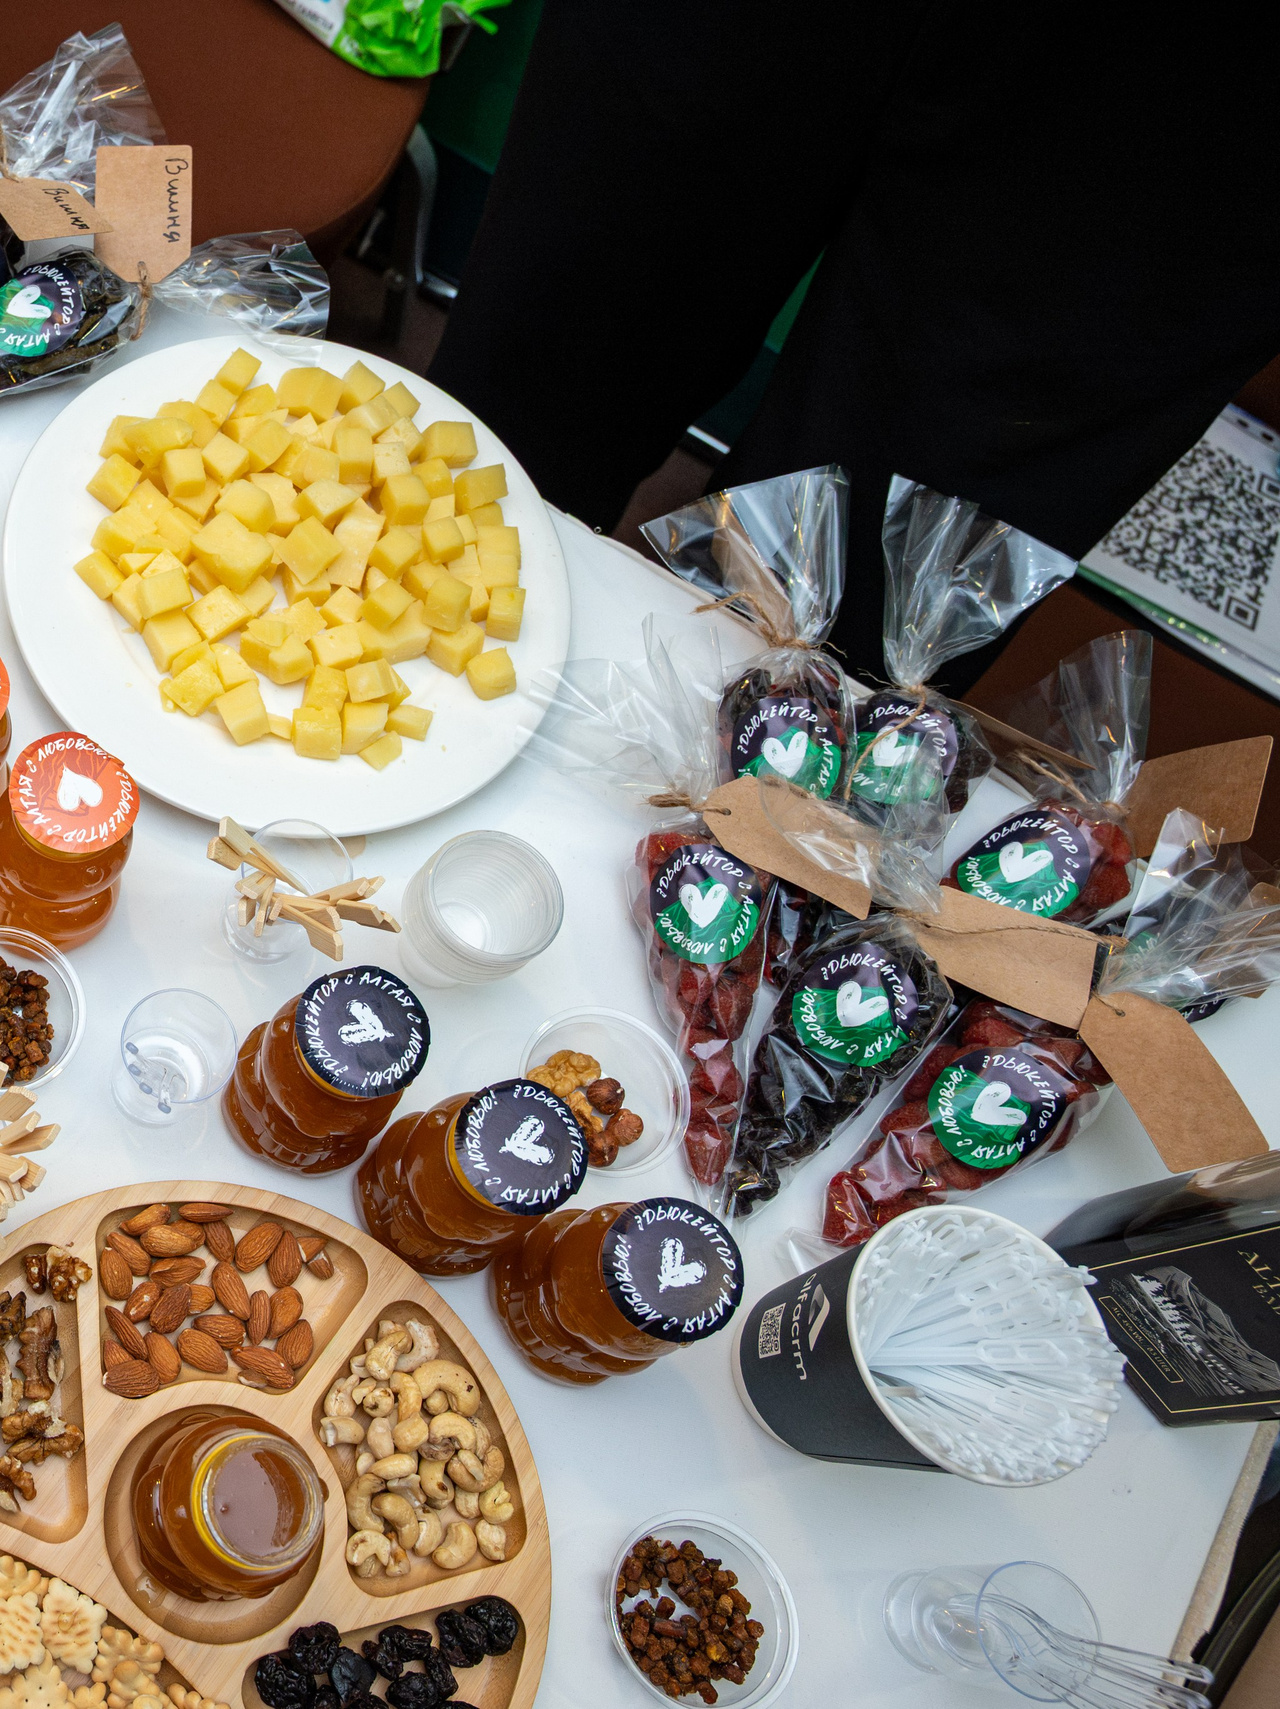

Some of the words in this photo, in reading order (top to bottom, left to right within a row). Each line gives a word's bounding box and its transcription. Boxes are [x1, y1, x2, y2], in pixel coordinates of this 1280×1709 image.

[54, 323, 61, 335] С
[4, 329, 50, 348] АЛТАЯ
[814, 725, 827, 733] С
[26, 759, 37, 773] С
[818, 737, 835, 788] АЛТАЯ
[19, 774, 52, 825] АЛТАЯ
[47, 824, 62, 835] С
[1065, 857, 1080, 869] С
[738, 881, 752, 890] С
[1032, 869, 1076, 912] АЛТАЯ
[731, 894, 754, 945] АЛТАЯ
[720, 938, 727, 952] С
[344, 974, 353, 985] С
[359, 972, 415, 1007] АЛТАЯ
[407, 1012, 421, 1024] С
[894, 1007, 907, 1020] С
[846, 1044, 859, 1055] С
[956, 1138, 973, 1147] С
[1030, 1129, 1036, 1142] С
[971, 1137, 1026, 1159] АЛТАЯ
[485, 1177, 502, 1186] С
[564, 1173, 571, 1190] С
[500, 1180, 560, 1206] АЛТАЯ
[723, 1274, 737, 1289] С
[682, 1287, 732, 1333] АЛТАЯ
[663, 1317, 678, 1330] С
[791, 1272, 818, 1381] alfacrm
